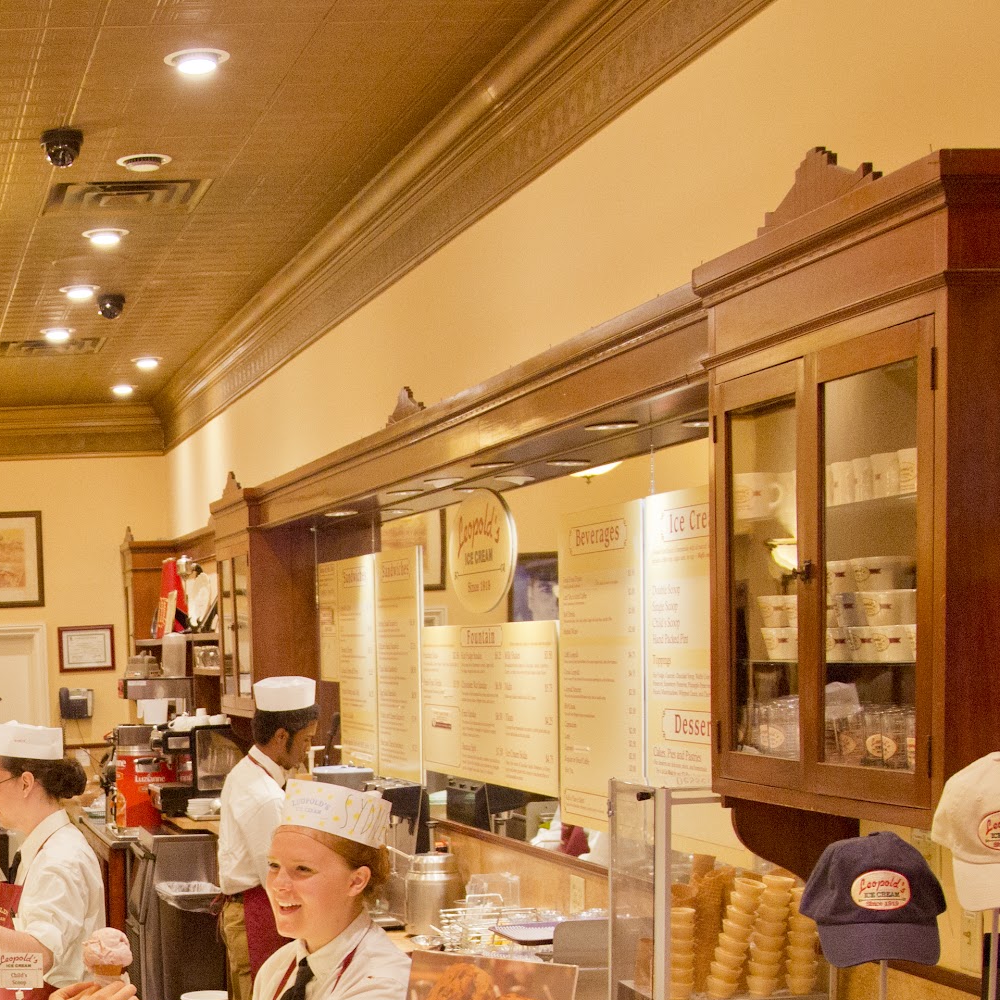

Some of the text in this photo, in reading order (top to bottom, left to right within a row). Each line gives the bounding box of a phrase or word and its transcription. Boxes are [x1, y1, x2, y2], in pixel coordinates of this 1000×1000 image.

[457, 503, 500, 557] Leopold's
[670, 510, 708, 533] Ice Cre
[575, 525, 620, 548] Beverages
[465, 548, 494, 565] ICE CREAM
[466, 628, 496, 645] Fountain
[675, 714, 711, 736] Desser
[859, 876, 906, 895] Leopold's
[0, 953, 38, 966] Leopold's
